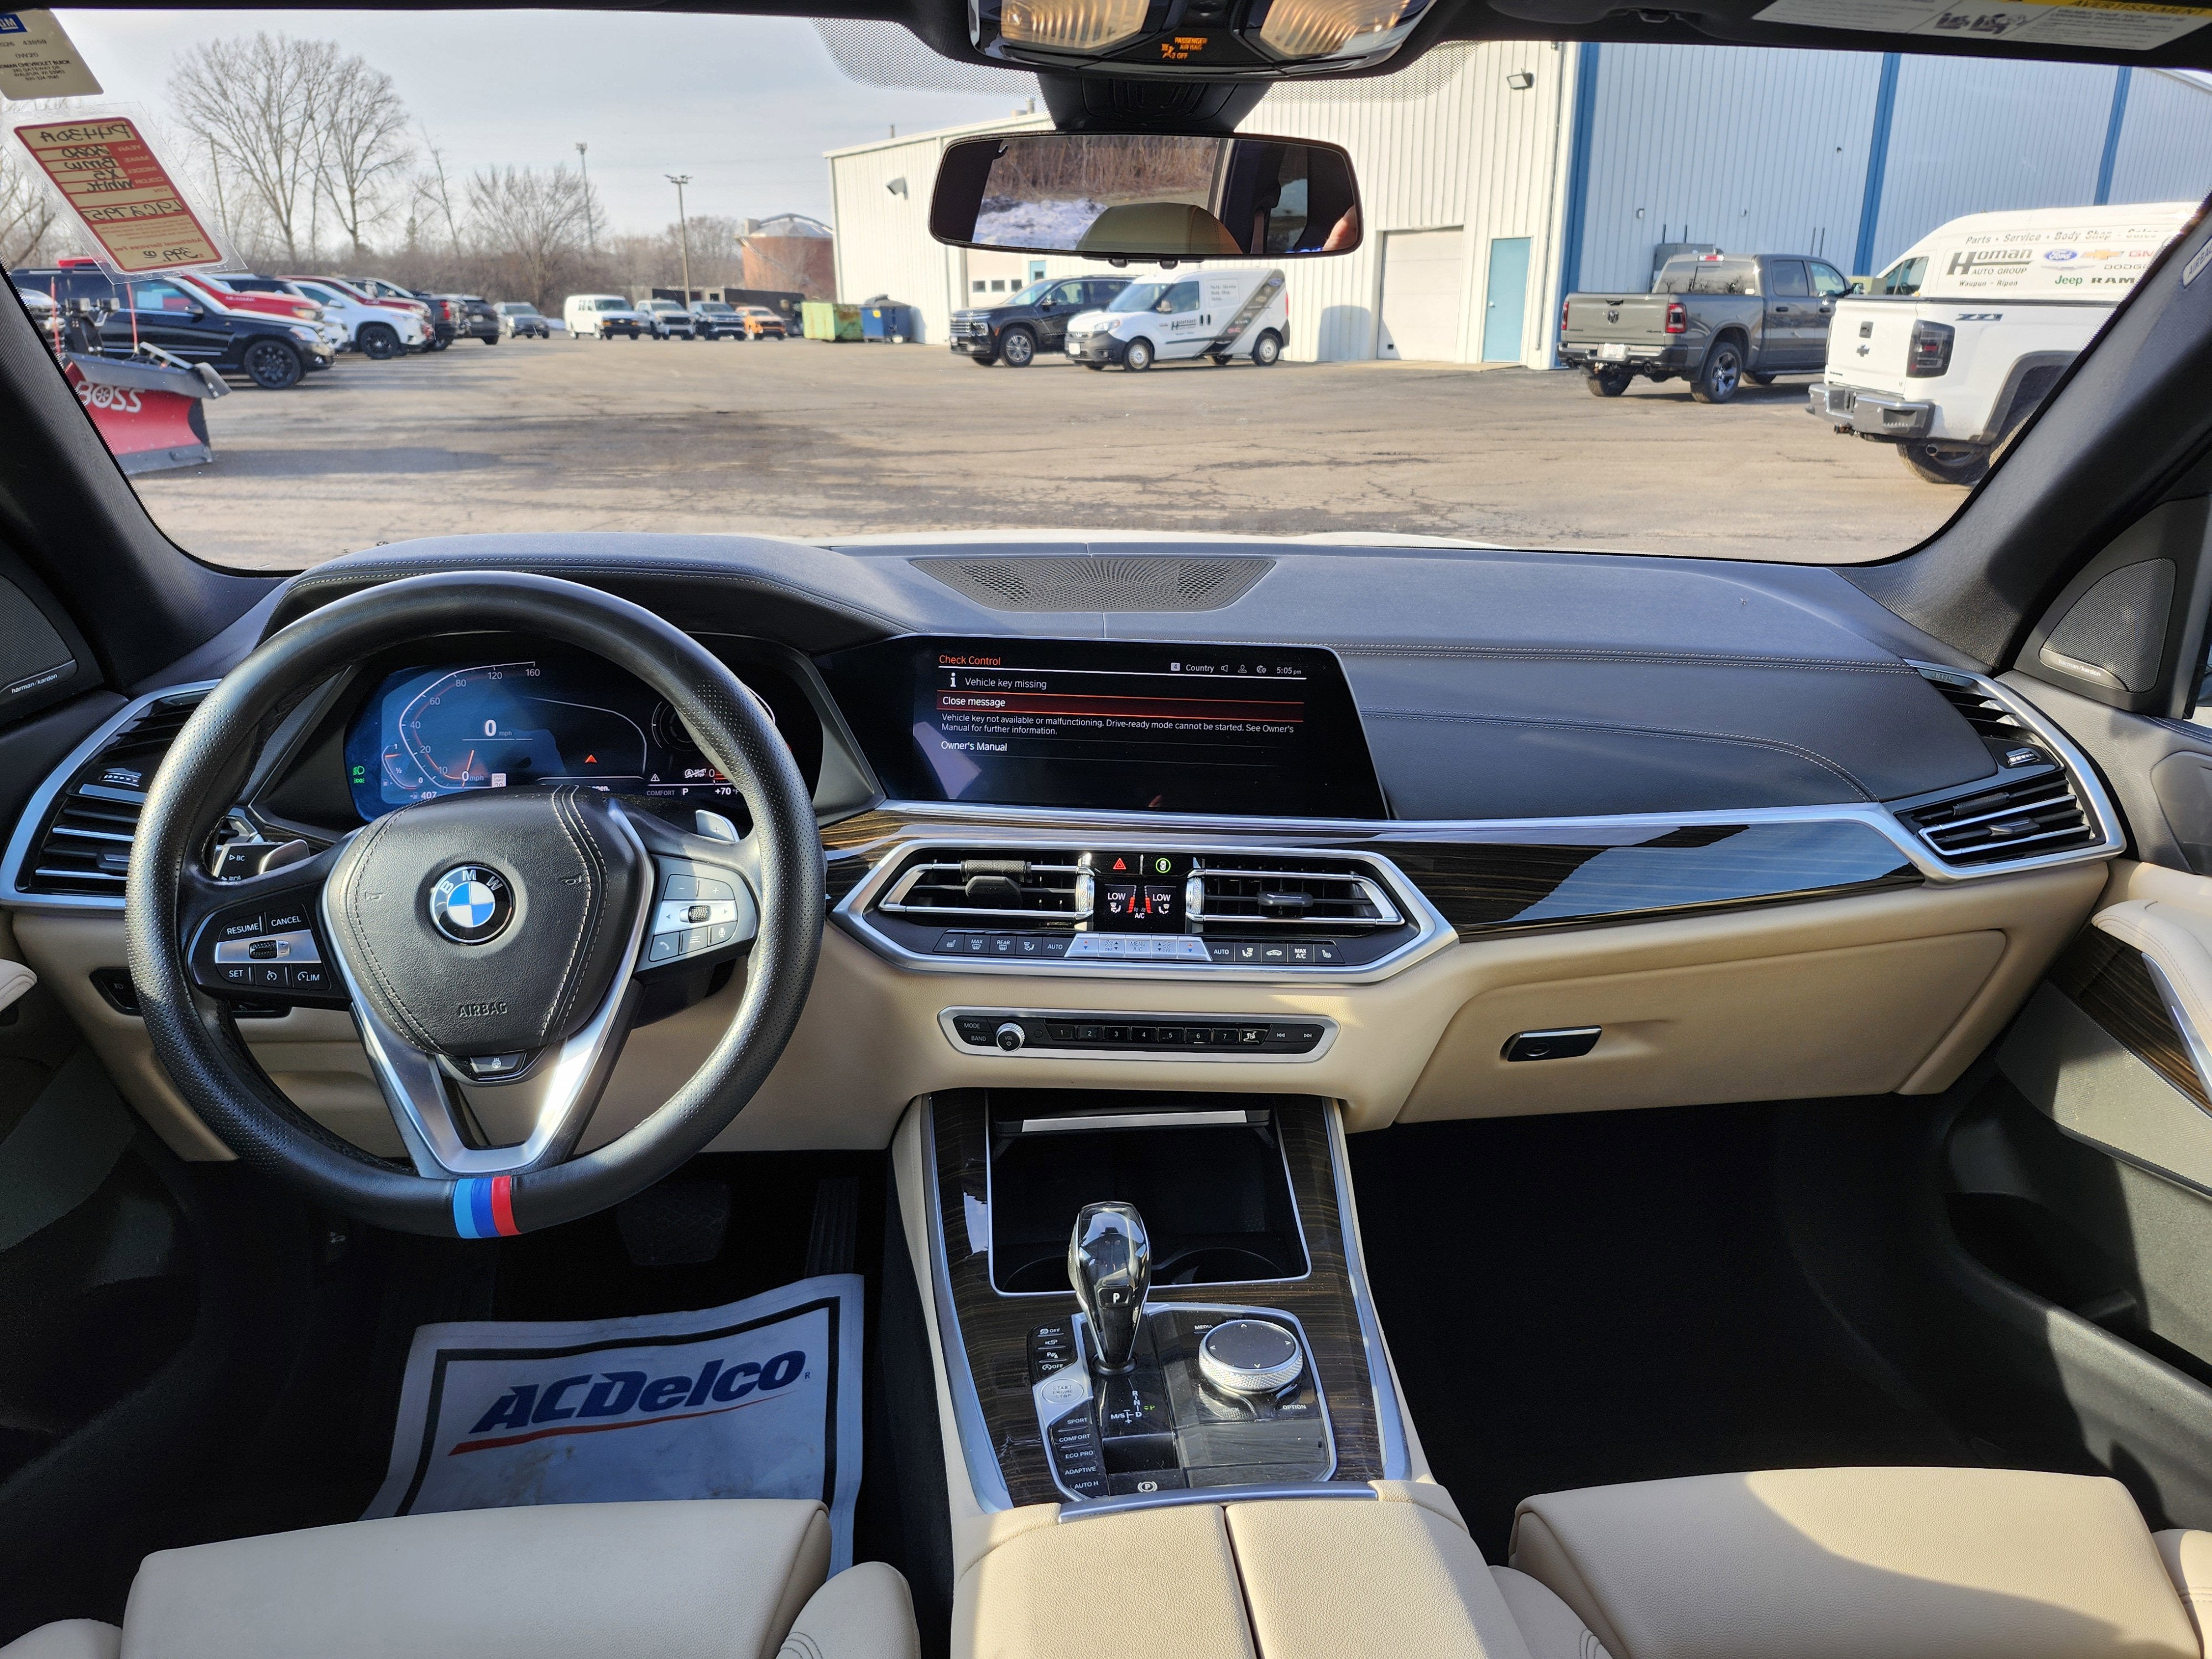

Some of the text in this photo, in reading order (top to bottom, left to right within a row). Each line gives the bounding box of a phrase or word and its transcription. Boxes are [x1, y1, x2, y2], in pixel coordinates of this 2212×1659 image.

[1965, 236, 1991, 244] Parts
[2004, 233, 2041, 242] Service
[2054, 231, 2080, 241] Body
[1947, 249, 2033, 275] Homan
[2055, 275, 2083, 286] Jeep
[939, 655, 1000, 665] Check Control
[1186, 664, 1214, 673] Country
[2059, 659, 2101, 676] harman/kardon
[12, 674, 58, 693] harman/kardon
[965, 677, 1047, 690] Vehicle key missing
[942, 696, 1006, 708] Close message
[484, 719, 497, 737] 0
[971, 724, 982, 732] for
[984, 724, 1009, 733] further
[1011, 726, 1057, 734] information.
[972, 714, 985, 723] key
[1046, 717, 1104, 728] malfunctioning.
[1107, 719, 1150, 730] Drive-ready
[1215, 723, 1244, 731] started.
[1246, 724, 1260, 732] See
[420, 745, 431, 753] 20
[941, 741, 1008, 751] Owner's Manual
[462, 771, 469, 781] 0
[440, 869, 503, 894] BMW
[227, 916, 301, 935] RESUME CANCEL
[459, 1002, 508, 1017] AIRBAG
[1113, 1293, 1120, 1303] P
[468, 1349, 806, 1433] ACDelco
[1059, 1433, 1090, 1443] COMFORT
[1065, 1467, 1096, 1475] ADAPTIVE
